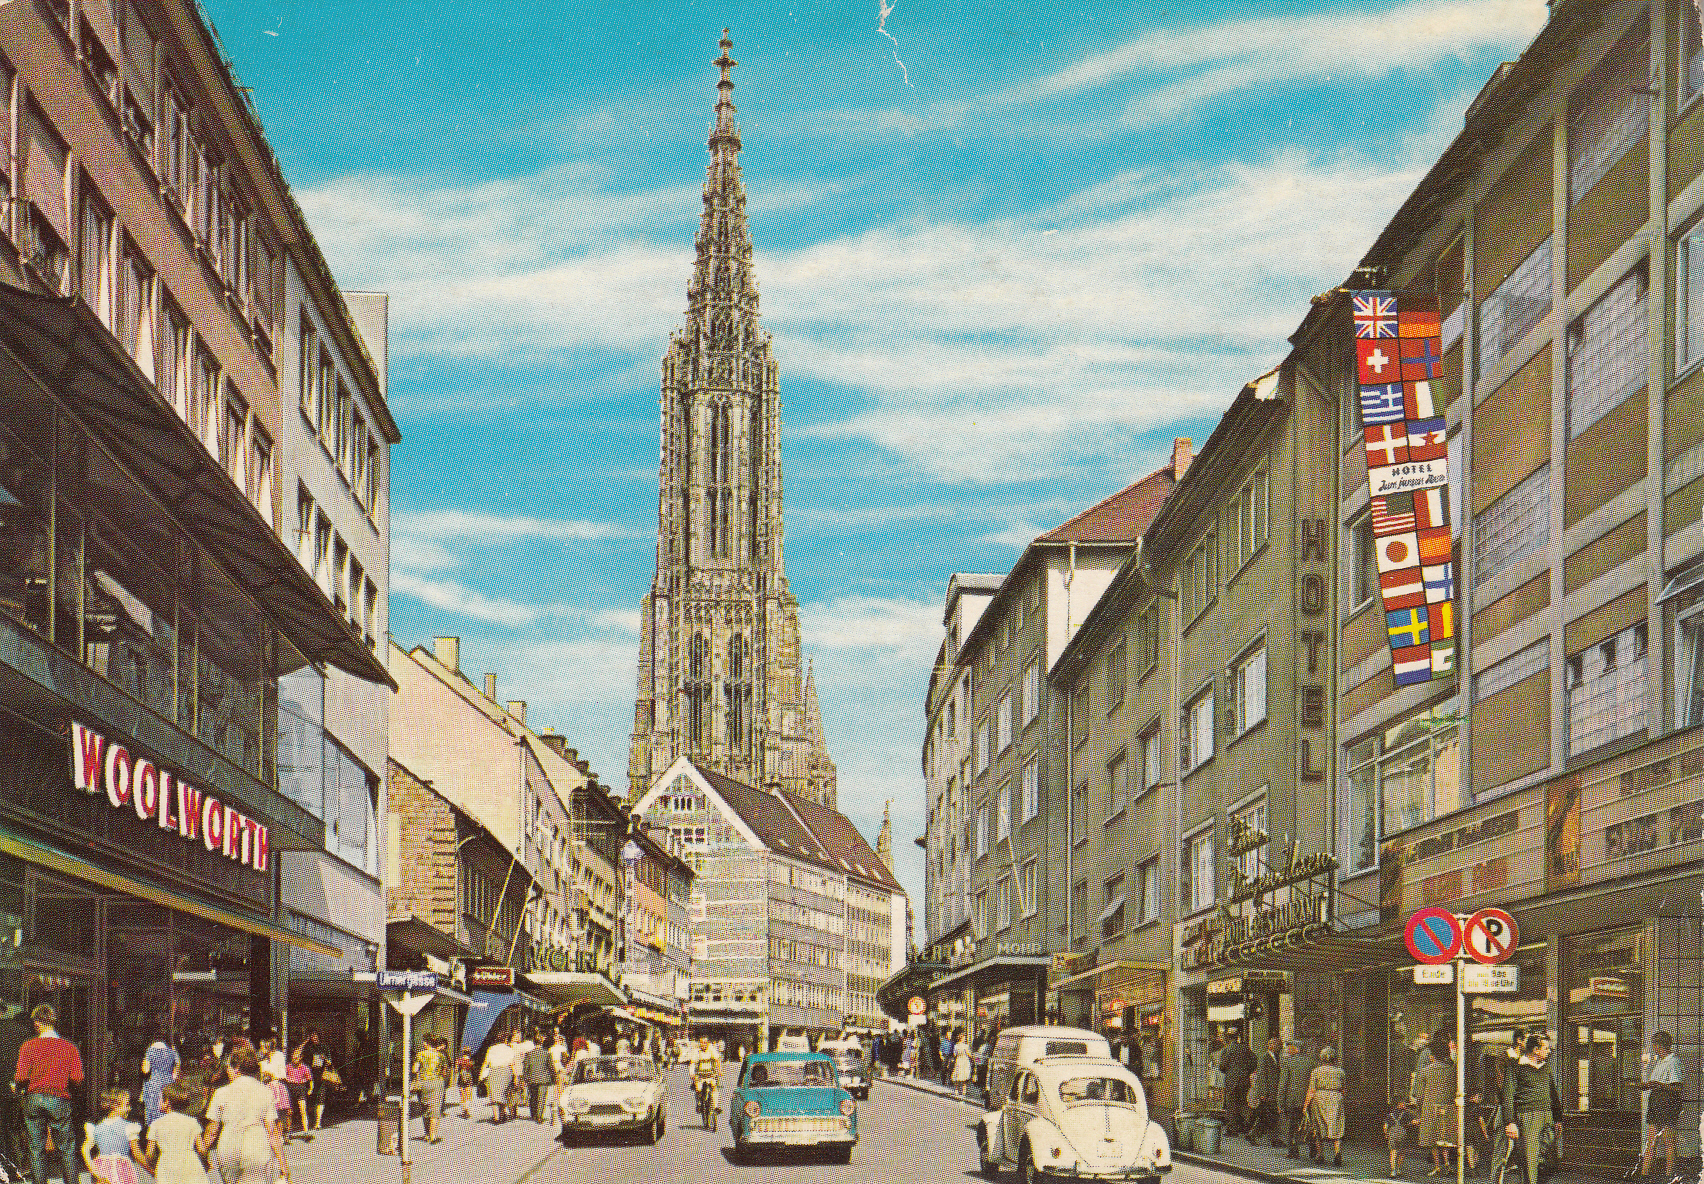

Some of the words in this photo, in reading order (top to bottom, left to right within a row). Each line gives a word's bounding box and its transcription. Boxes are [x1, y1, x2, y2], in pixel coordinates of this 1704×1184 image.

[1392, 464, 1432, 477] HOTEL
[1301, 518, 1326, 782] HOTEL
[72, 720, 269, 872] WOOLWORTH
[997, 942, 1042, 955] MOHR
[1421, 969, 1446, 979] Ende
